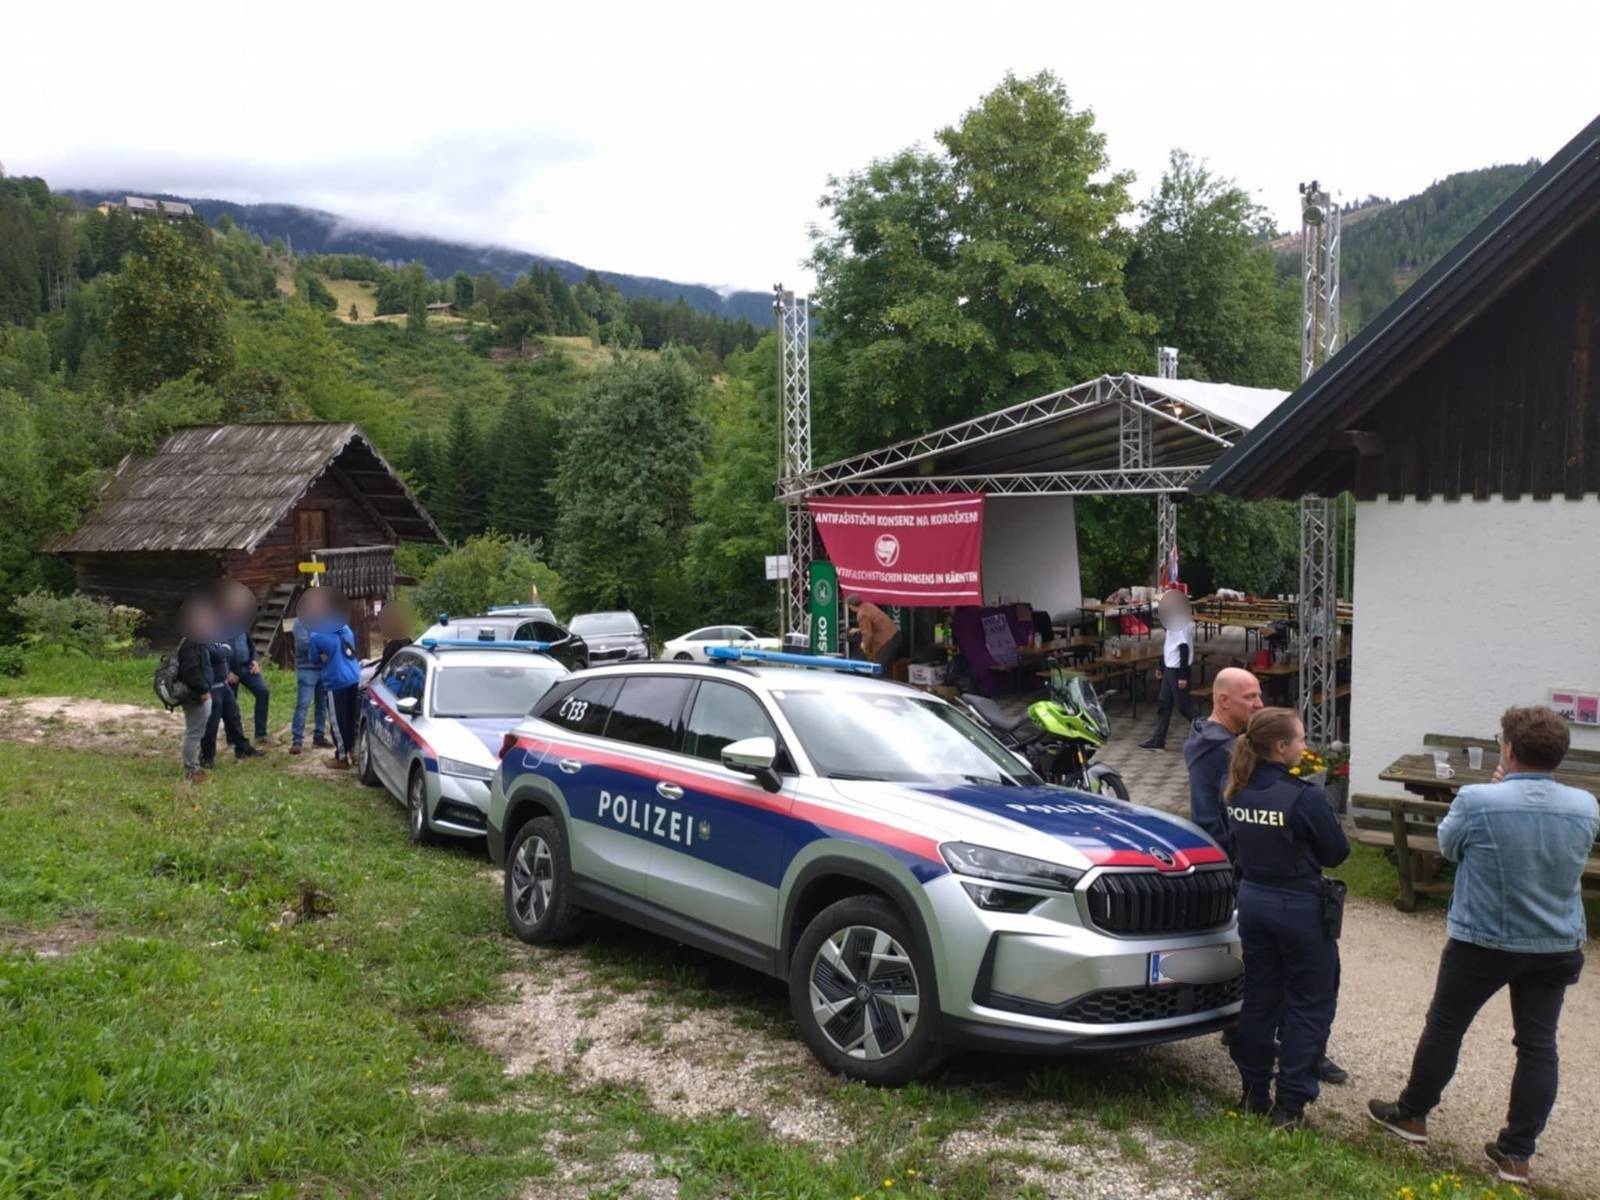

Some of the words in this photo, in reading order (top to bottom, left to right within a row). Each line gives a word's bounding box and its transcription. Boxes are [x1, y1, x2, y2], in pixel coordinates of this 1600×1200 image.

[877, 515, 915, 527] KONSENZ
[916, 515, 930, 527] NA
[930, 510, 979, 525] KOROŠKEM
[835, 566, 902, 583] NTIFASCHISTISCHEN
[903, 572, 935, 585] KONSENS
[936, 573, 944, 584] IN
[945, 570, 978, 584] KÄRNTEN
[817, 616, 828, 654] ŠKO
[567, 700, 588, 721] 133
[598, 790, 694, 846] POLIZEI
[1226, 806, 1284, 826] POLIZEI
